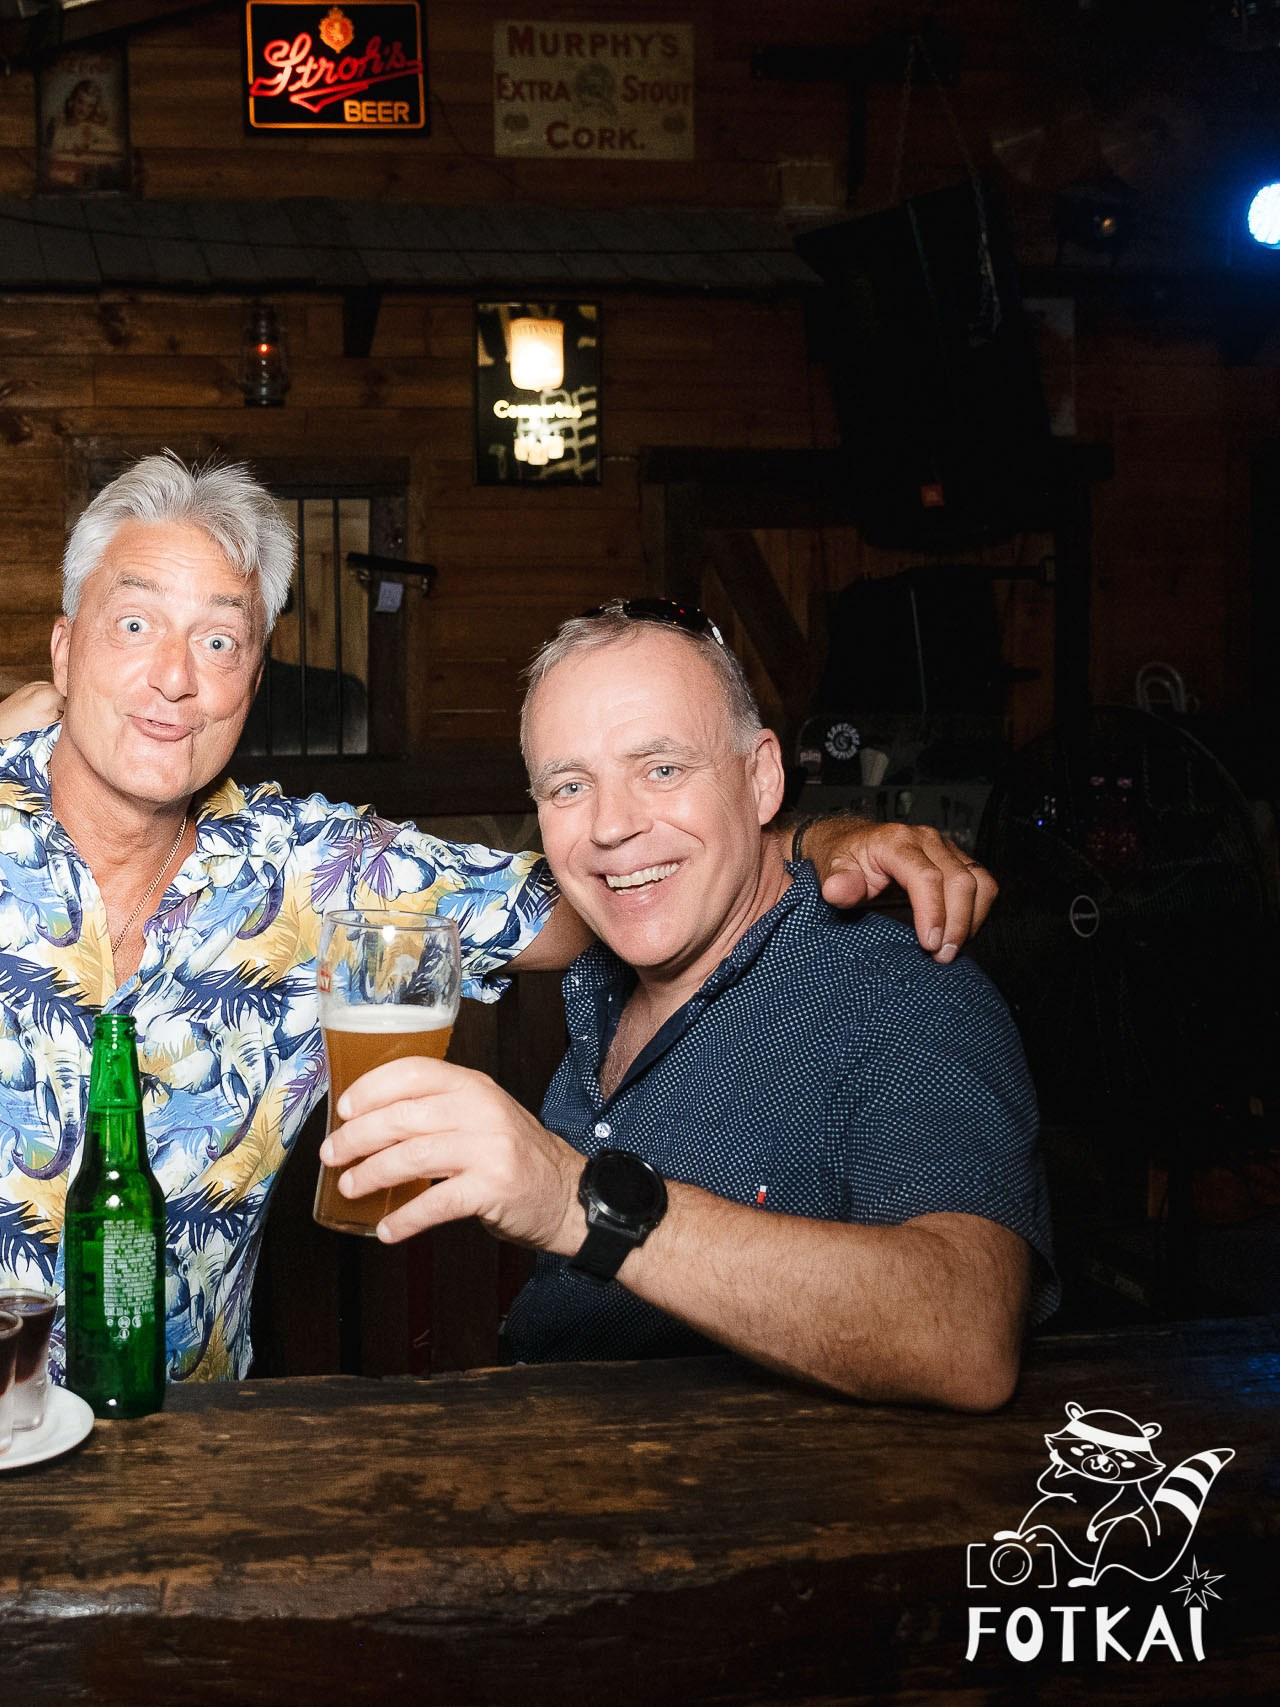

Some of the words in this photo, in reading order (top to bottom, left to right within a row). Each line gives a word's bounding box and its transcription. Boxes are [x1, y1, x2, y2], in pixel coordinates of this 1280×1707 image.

[508, 25, 680, 58] MURPHY'S
[250, 32, 423, 108] Stroh's
[496, 73, 570, 102] EXTRA
[622, 74, 691, 104] STOUT
[343, 100, 411, 123] BEER
